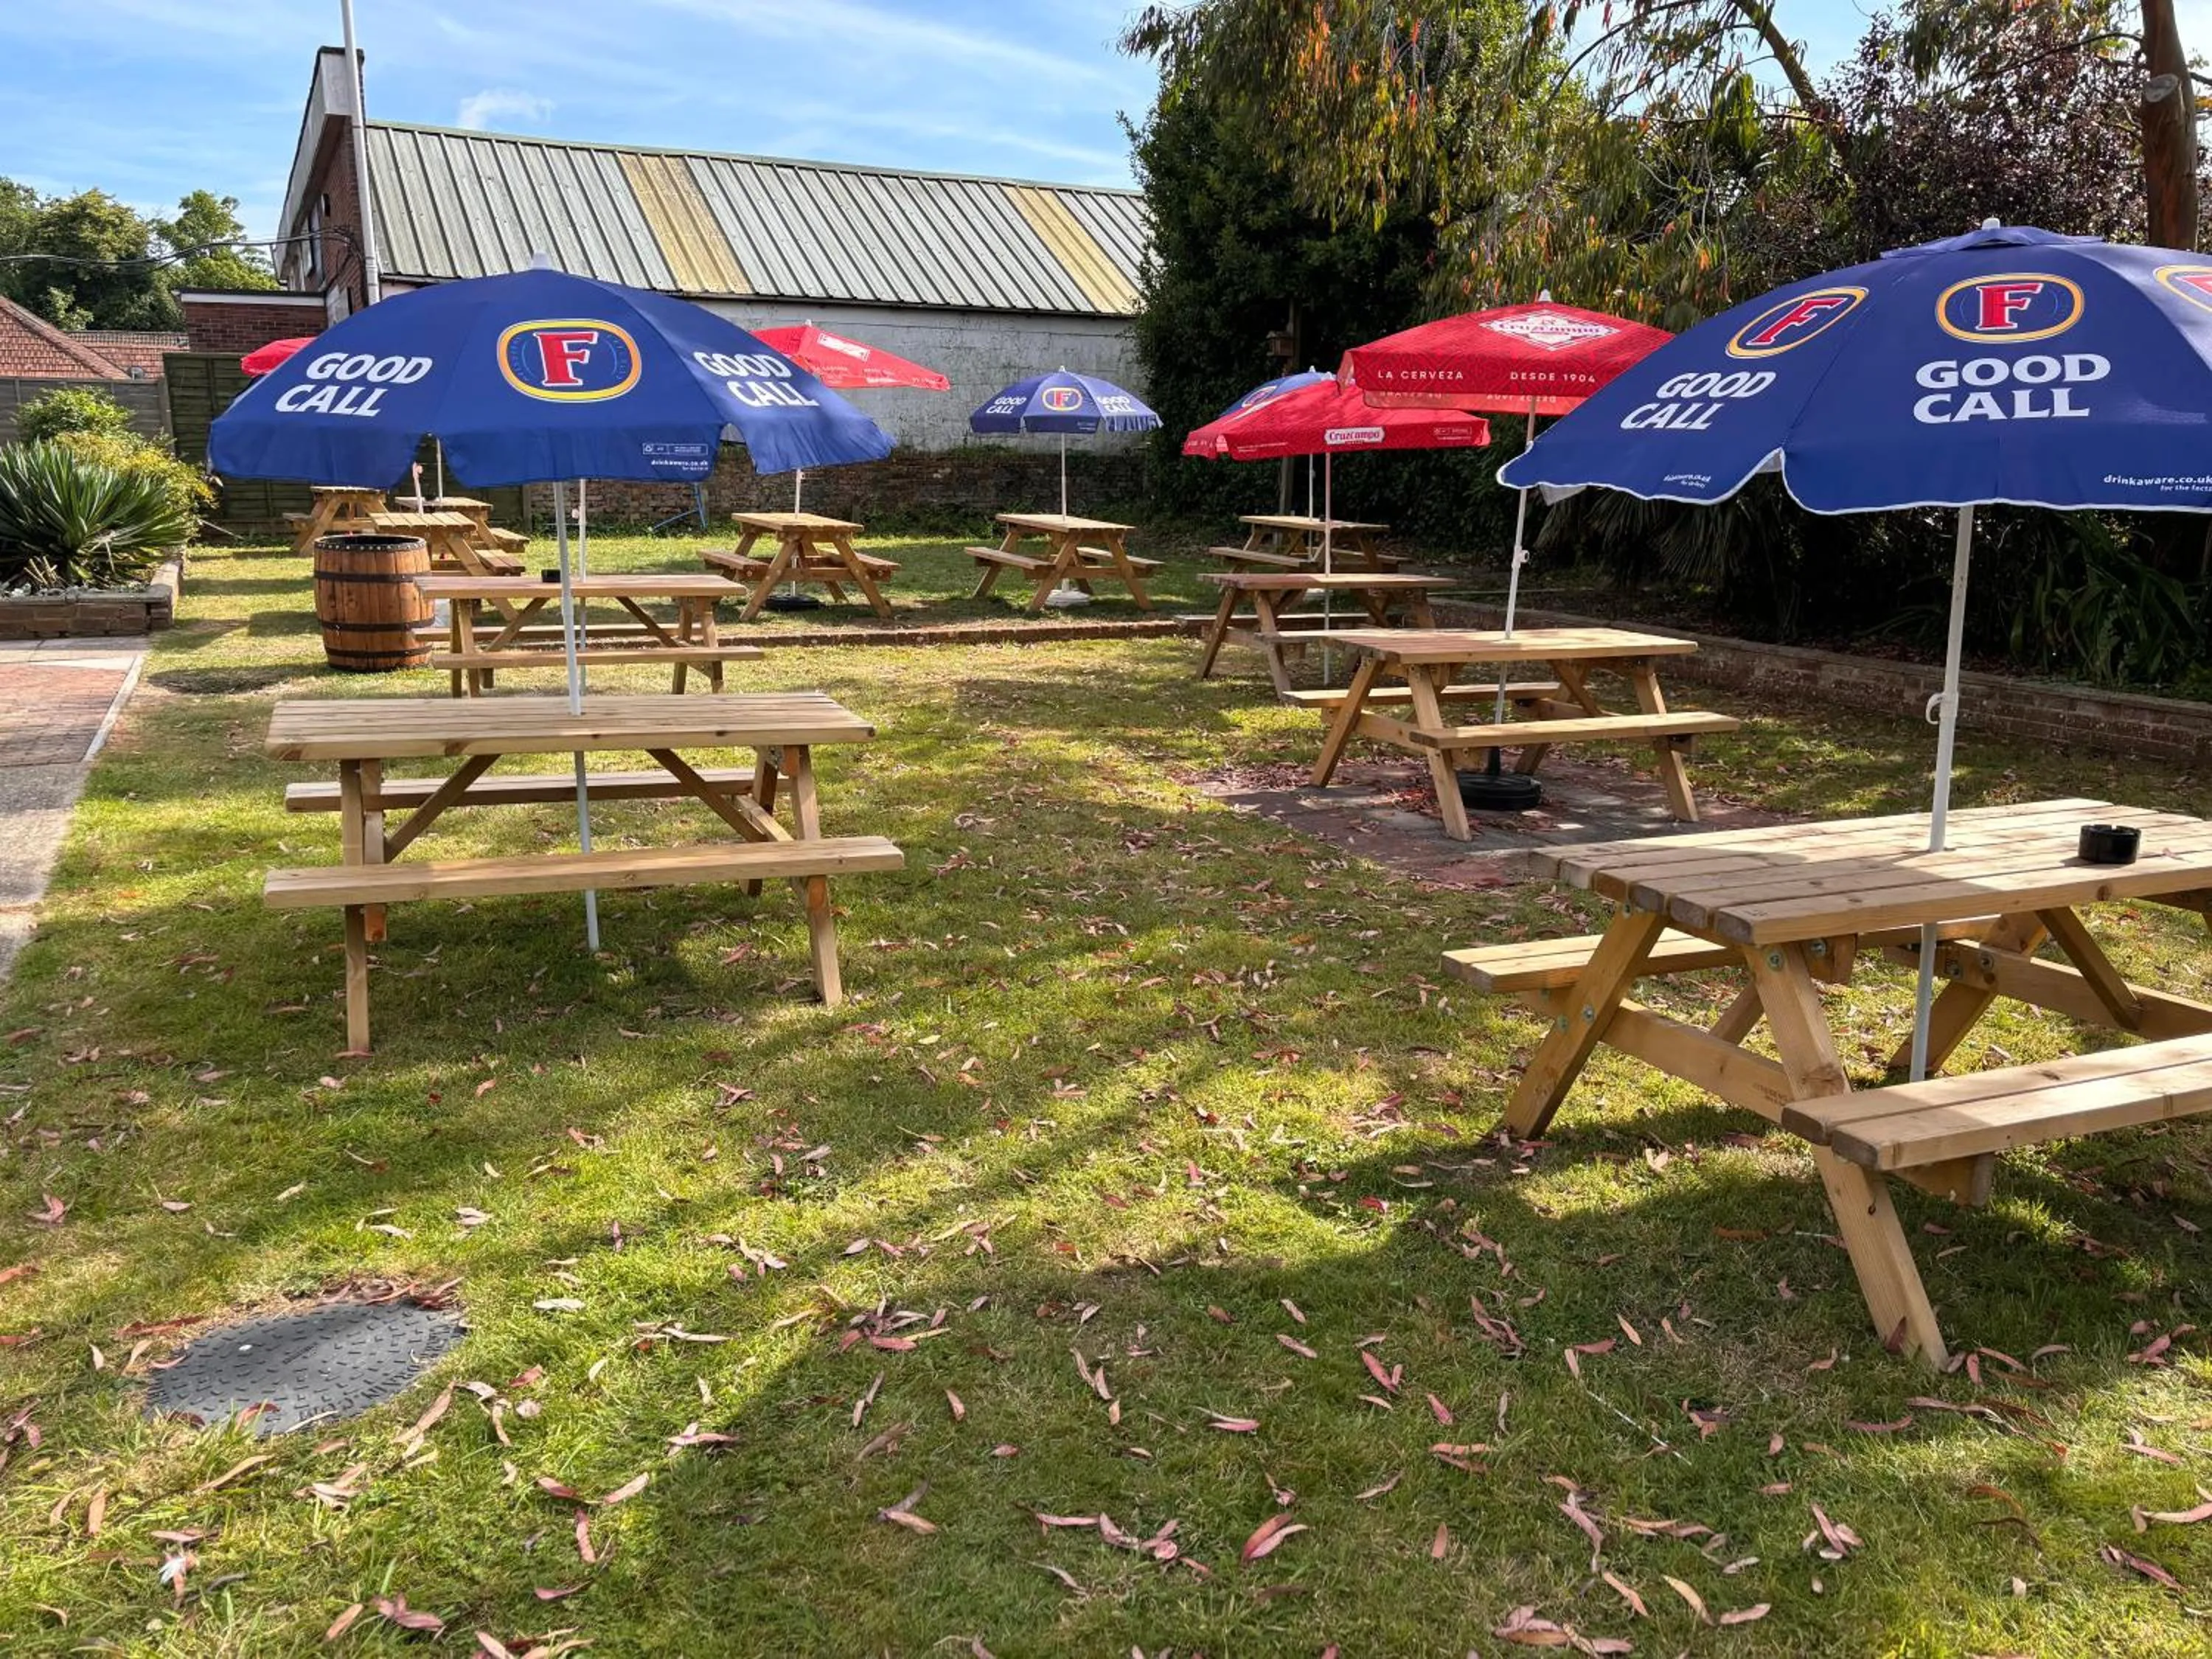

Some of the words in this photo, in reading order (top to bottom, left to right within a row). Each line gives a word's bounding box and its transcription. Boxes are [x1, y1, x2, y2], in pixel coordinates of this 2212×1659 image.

[1975, 283, 2043, 330] F
[1746, 297, 1848, 345] F
[306, 352, 433, 384] GOOD
[533, 331, 599, 387] F
[692, 351, 793, 378] GOOD
[1916, 353, 2111, 389] GOOD
[1377, 370, 1393, 379] LA
[1400, 371, 1464, 380] CERVEZA
[1510, 372, 1556, 381] DESDE
[1563, 374, 1596, 383] 1904
[1656, 371, 1776, 399] GOOD
[275, 384, 389, 417] CALL
[726, 380, 820, 407] CALL
[994, 397, 1027, 405] GOOD
[1913, 388, 2090, 424] CALL
[986, 405, 1015, 414] CALL
[1620, 403, 1725, 429] CALL
[1329, 431, 1380, 441] Cruzcampo
[2103, 474, 2212, 486] drinkaware.co.uk
